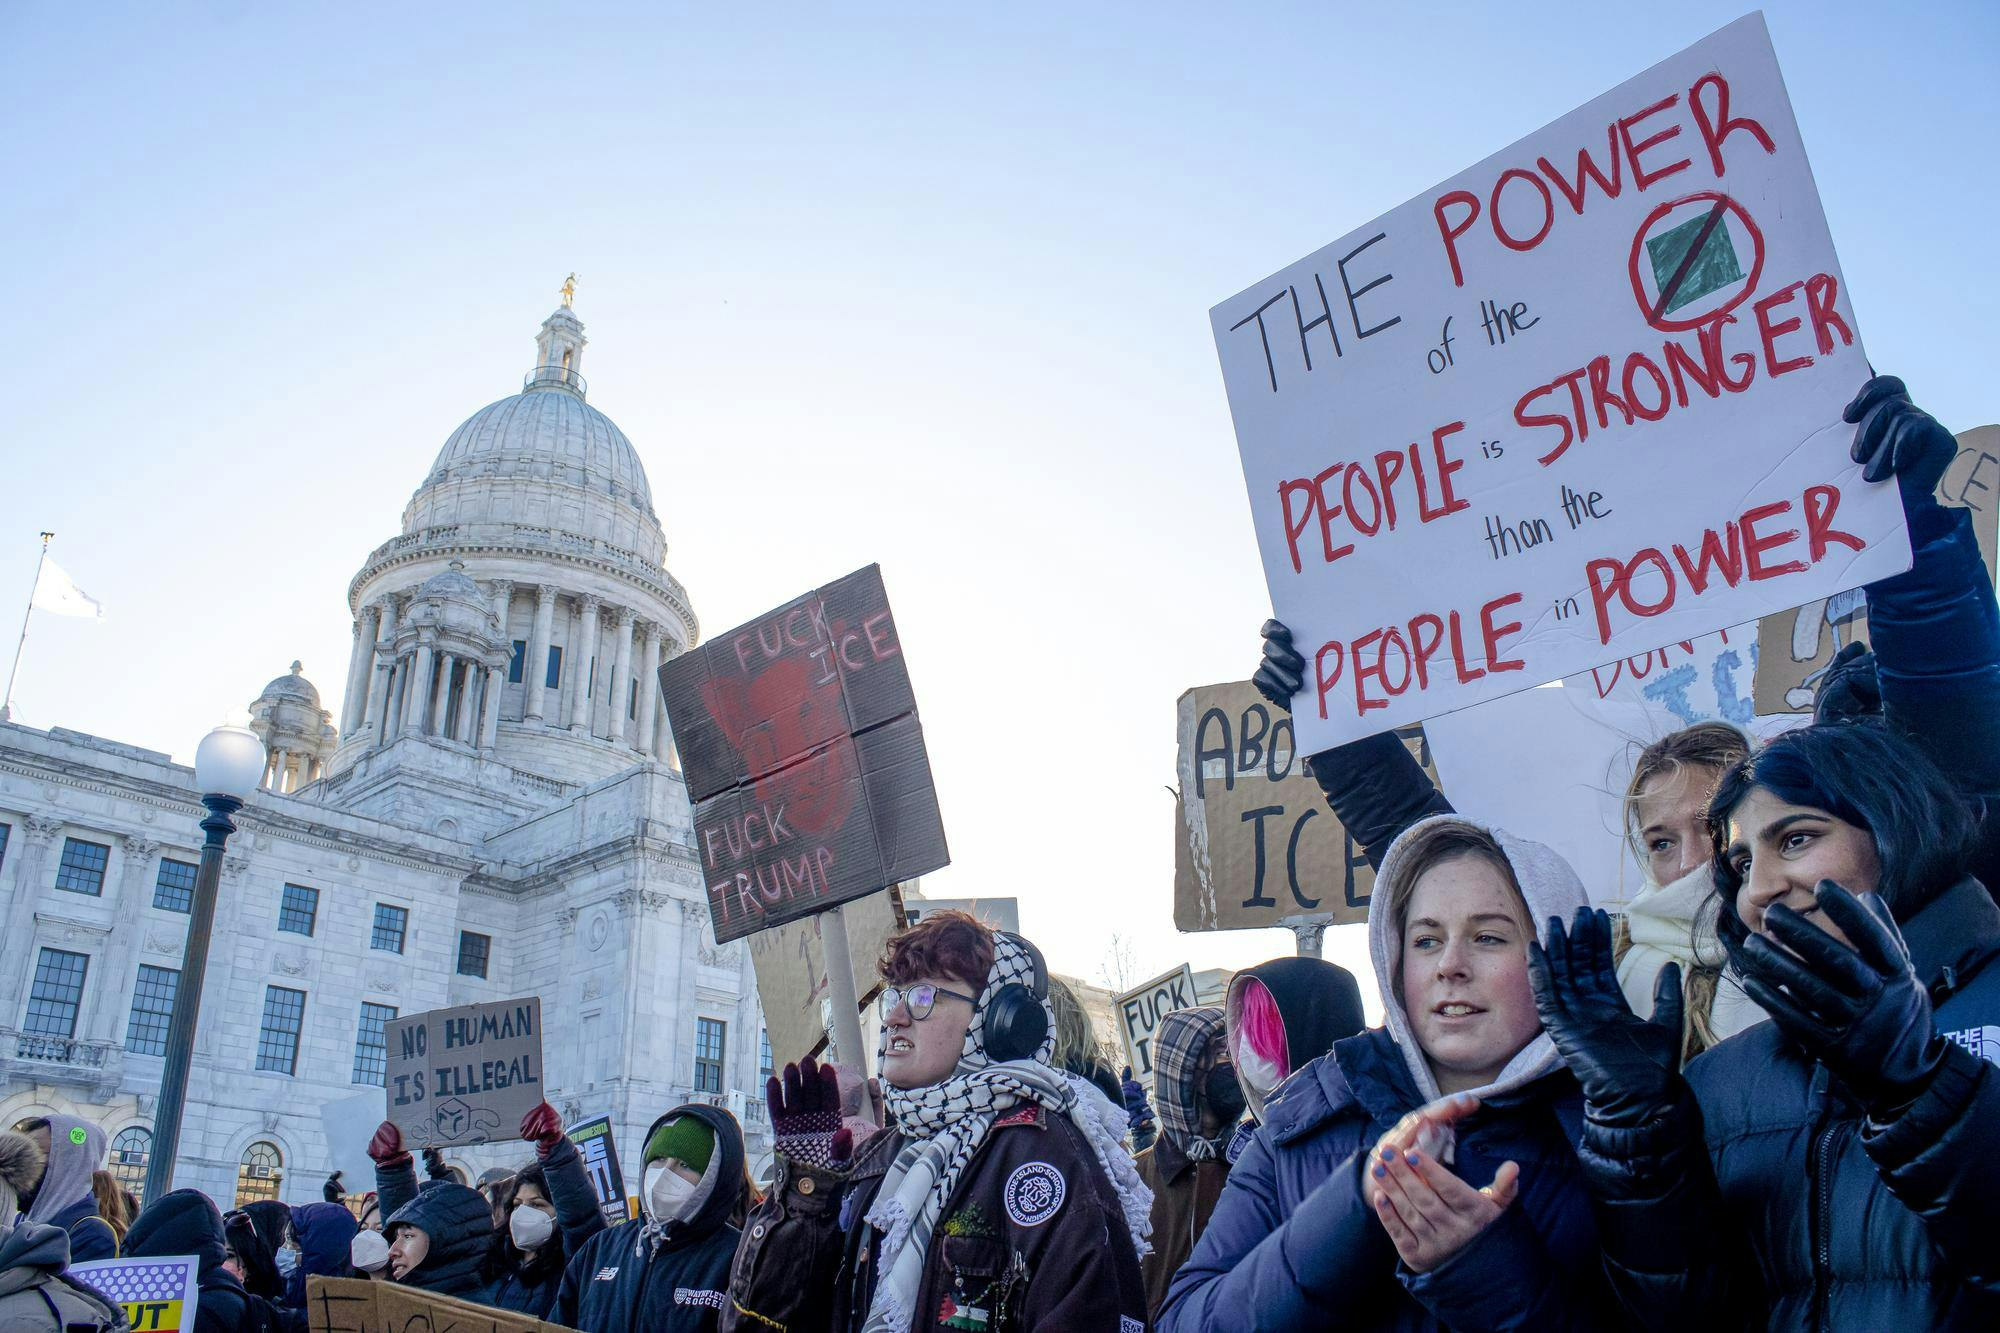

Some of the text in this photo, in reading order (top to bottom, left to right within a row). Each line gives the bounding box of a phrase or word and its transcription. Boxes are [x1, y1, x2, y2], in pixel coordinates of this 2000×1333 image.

[1230, 72, 1776, 392] THE POWER
[1427, 300, 1540, 374] of the
[1278, 273, 1854, 574] PEOPLE is STRONGER
[1484, 485, 1613, 560] than the
[733, 600, 831, 673] FUCK
[1315, 592, 1526, 720] PEOPLE
[1554, 597, 1579, 621] in
[1585, 483, 1866, 646] POWER
[809, 612, 898, 687] ICE
[1641, 633, 1758, 724] IC
[704, 802, 795, 869] FUCK
[710, 846, 836, 926] TRUMP
[401, 1005, 532, 1060] NO HUMAN
[1123, 976, 1190, 1038] FUCK
[1943, 1027, 1981, 1045] THE
[394, 1055, 538, 1106] IS ILLEGAL
[1008, 1166, 1062, 1222] RHODE ISLAND SCHOOL OF DESIGN
